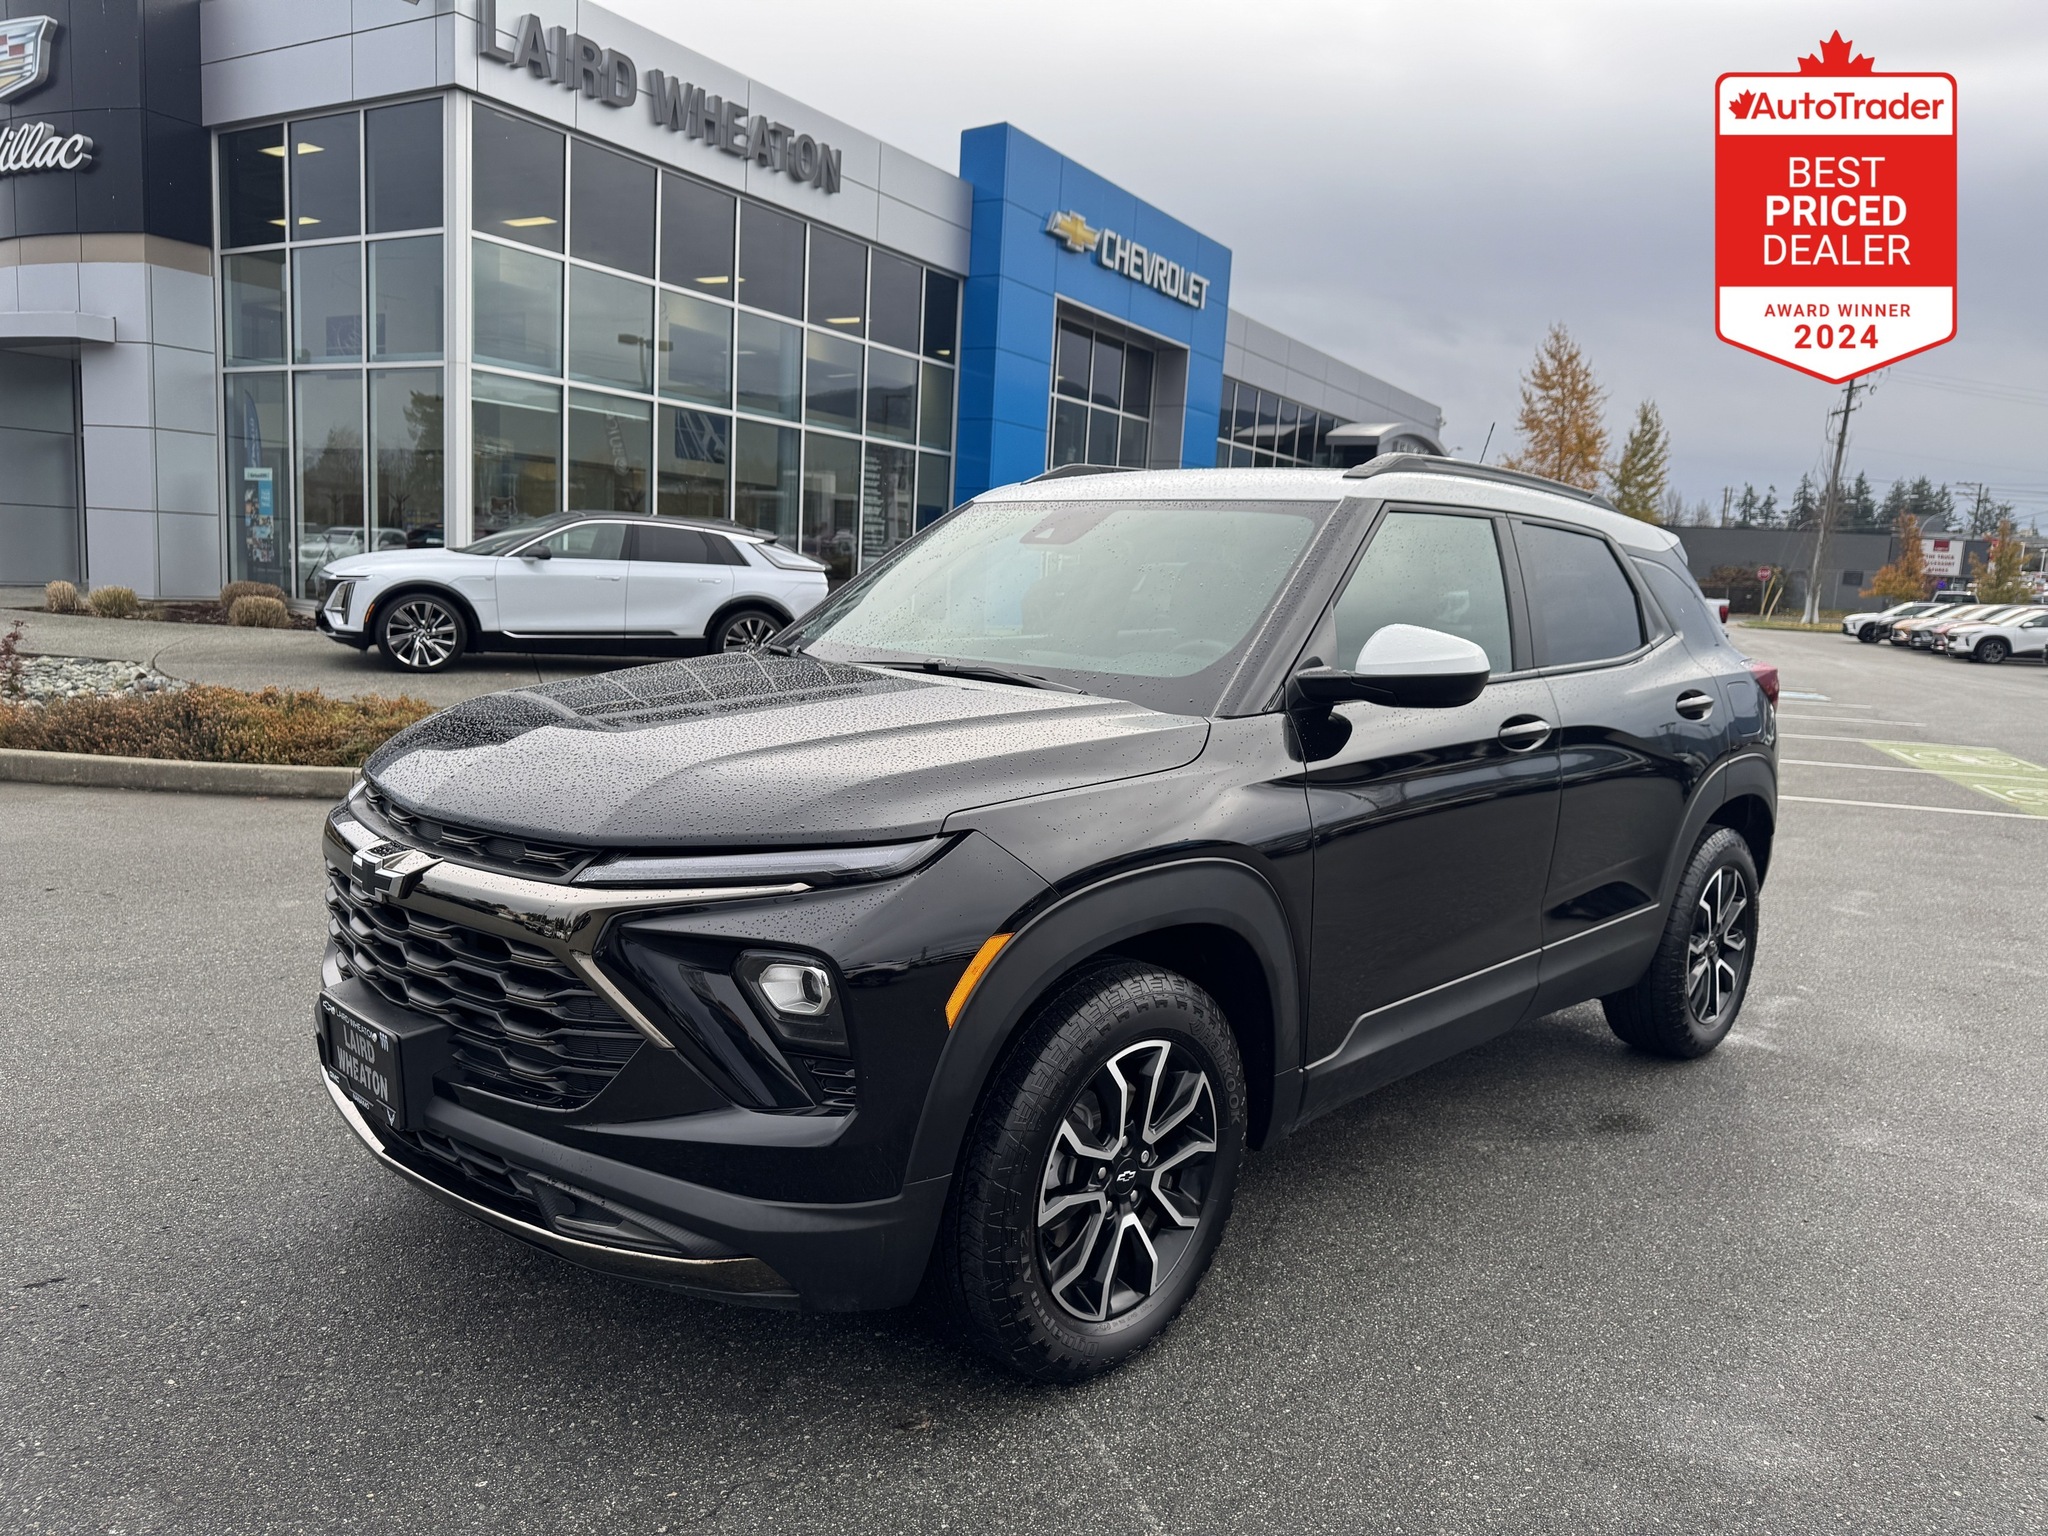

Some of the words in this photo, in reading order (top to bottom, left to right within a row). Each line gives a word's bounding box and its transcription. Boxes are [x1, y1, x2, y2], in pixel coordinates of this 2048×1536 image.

[476, 0, 637, 108] LAIRD
[647, 68, 842, 194] WHEATON
[0, 121, 90, 173] illac
[1101, 228, 1211, 310] CHEVROLET
[343, 1024, 376, 1064] LAIRD
[348, 1017, 374, 1039] WHEATO
[337, 1045, 389, 1102] WHEATON
